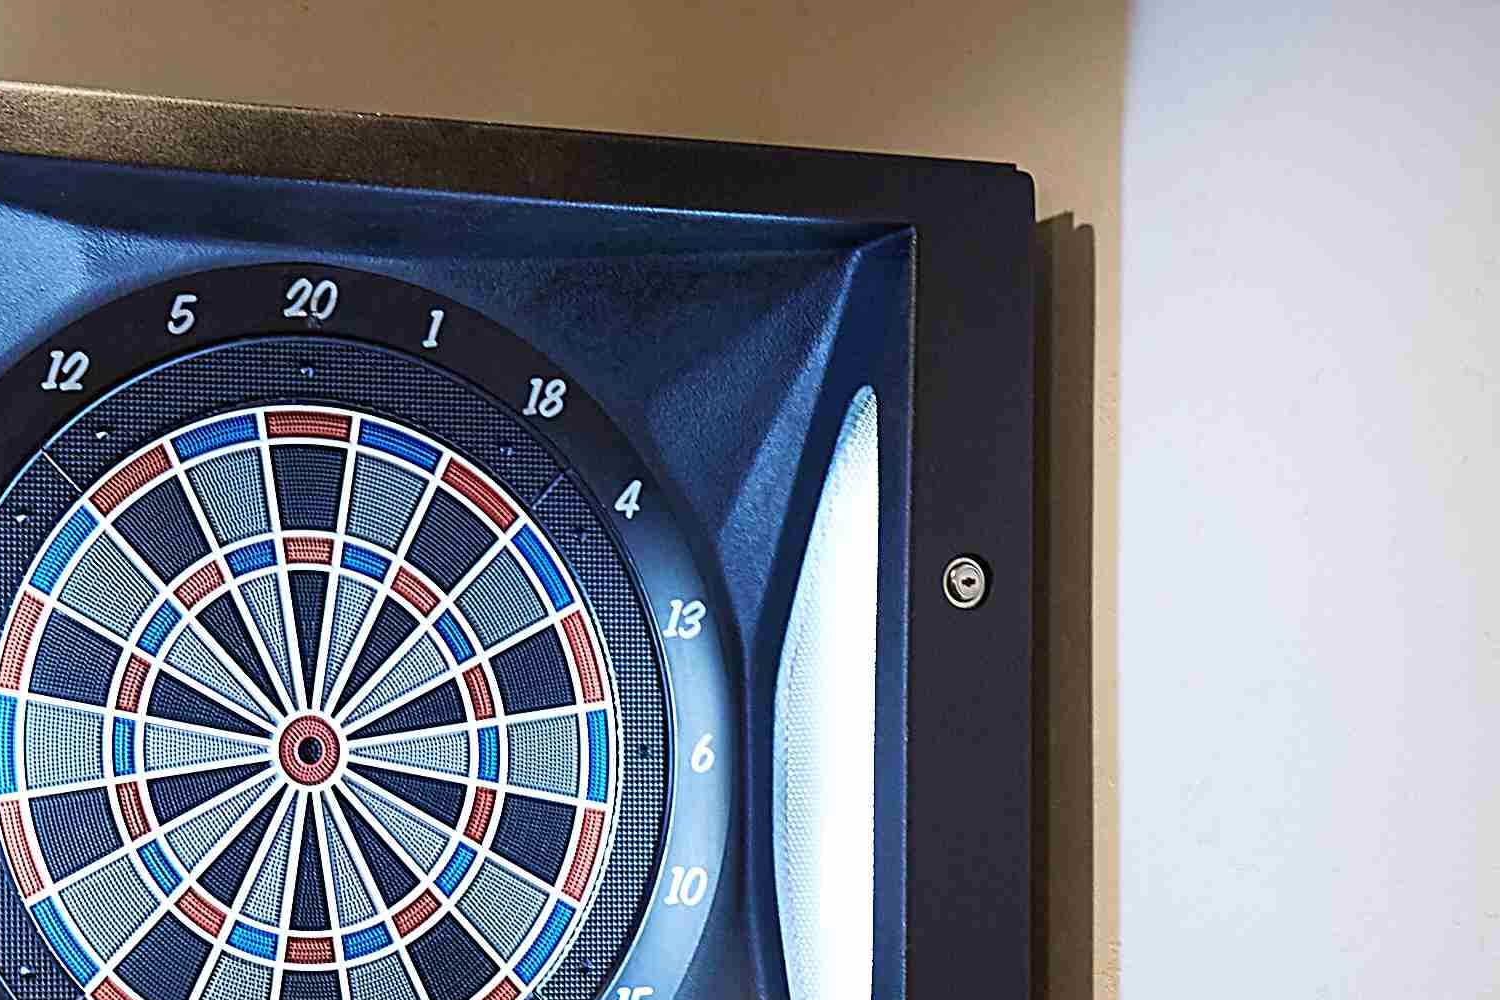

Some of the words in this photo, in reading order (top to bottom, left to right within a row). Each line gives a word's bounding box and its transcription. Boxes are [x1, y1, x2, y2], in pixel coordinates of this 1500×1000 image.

[166, 294, 198, 335] 5
[283, 278, 338, 321] 20
[422, 310, 445, 348] 1
[41, 350, 90, 391] 12
[522, 378, 567, 418] 18
[613, 479, 643, 520] 4
[663, 600, 707, 640] 13
[691, 732, 716, 774] 6
[664, 866, 709, 907] 10
